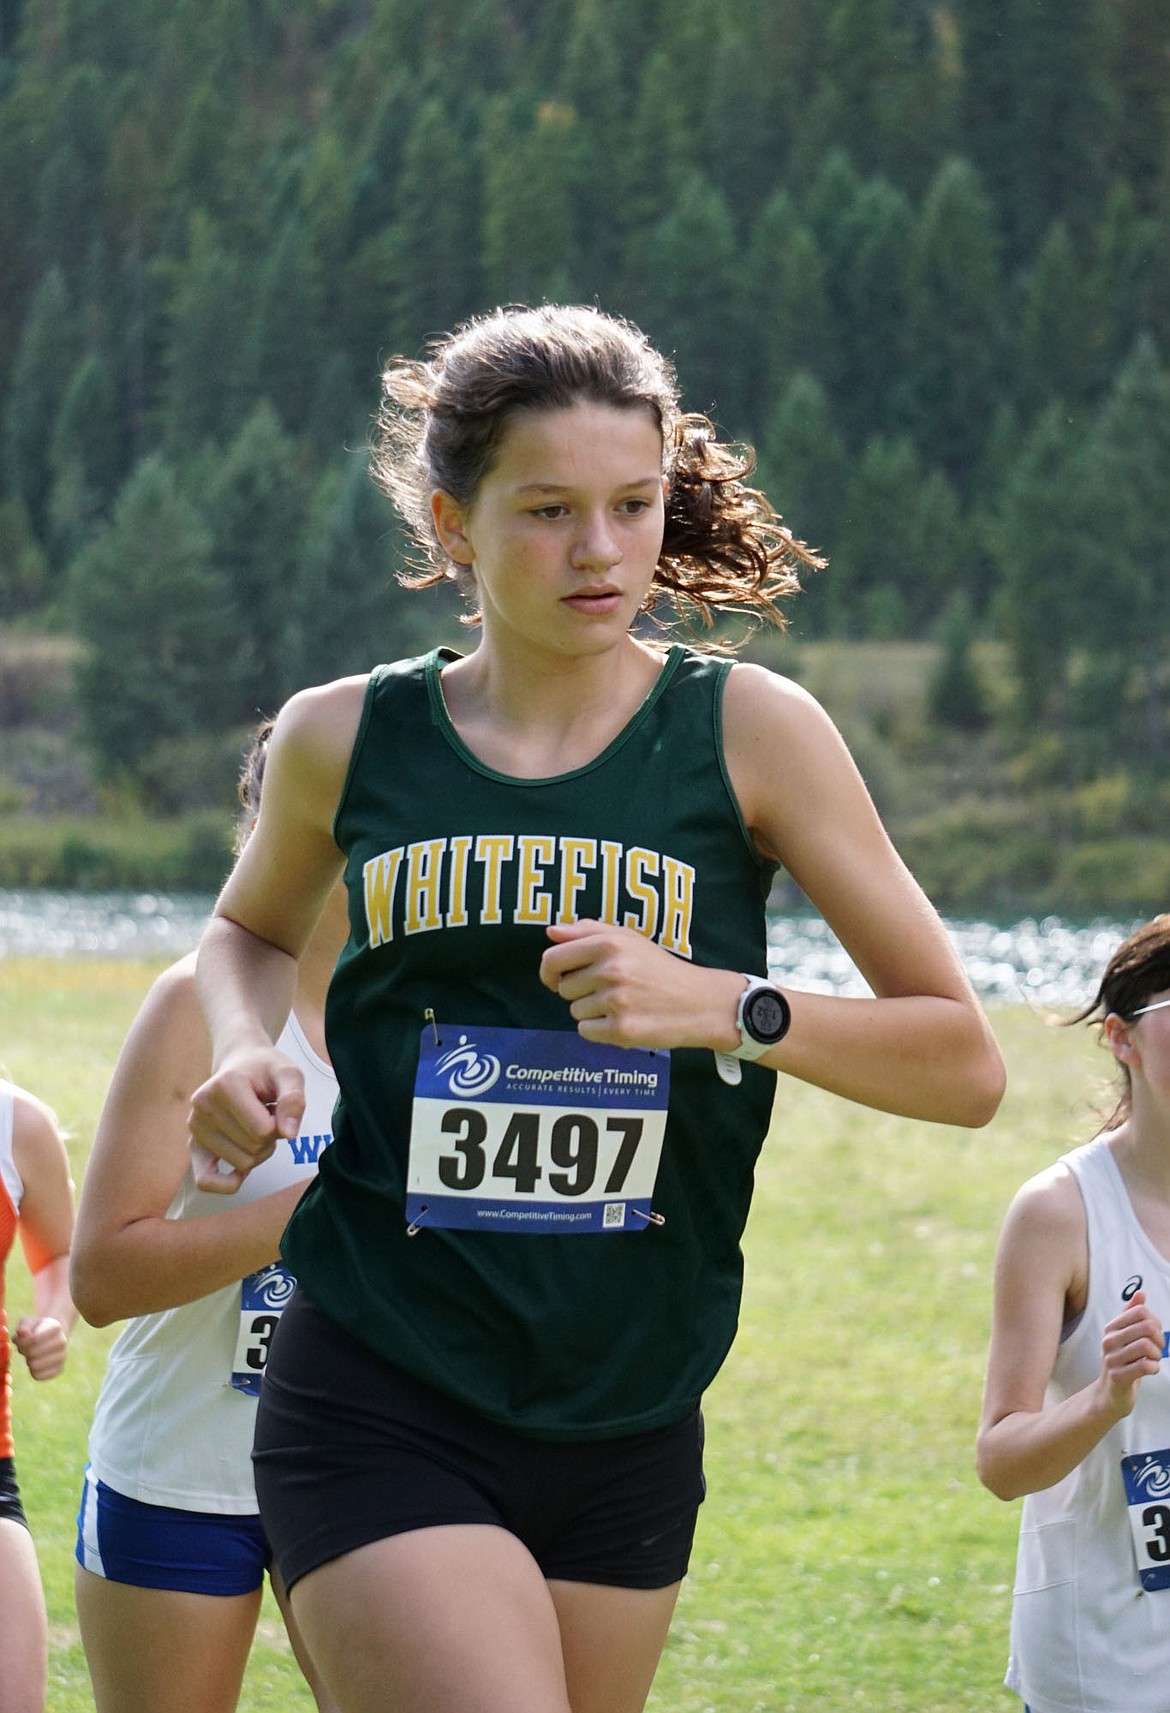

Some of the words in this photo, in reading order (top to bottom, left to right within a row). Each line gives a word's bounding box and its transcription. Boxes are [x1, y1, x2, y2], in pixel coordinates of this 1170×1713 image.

[363, 835, 696, 960] WHITEFISH
[506, 1065, 658, 1088] CompetitiveTiming
[506, 1083, 553, 1092] ACCURATE
[557, 1085, 596, 1094] RESULTS
[603, 1087, 631, 1095] EVERY
[635, 1088, 655, 1096] TIME
[438, 1107, 644, 1196] 3497
[477, 1209, 592, 1222] www.CompetitiveTiming.com
